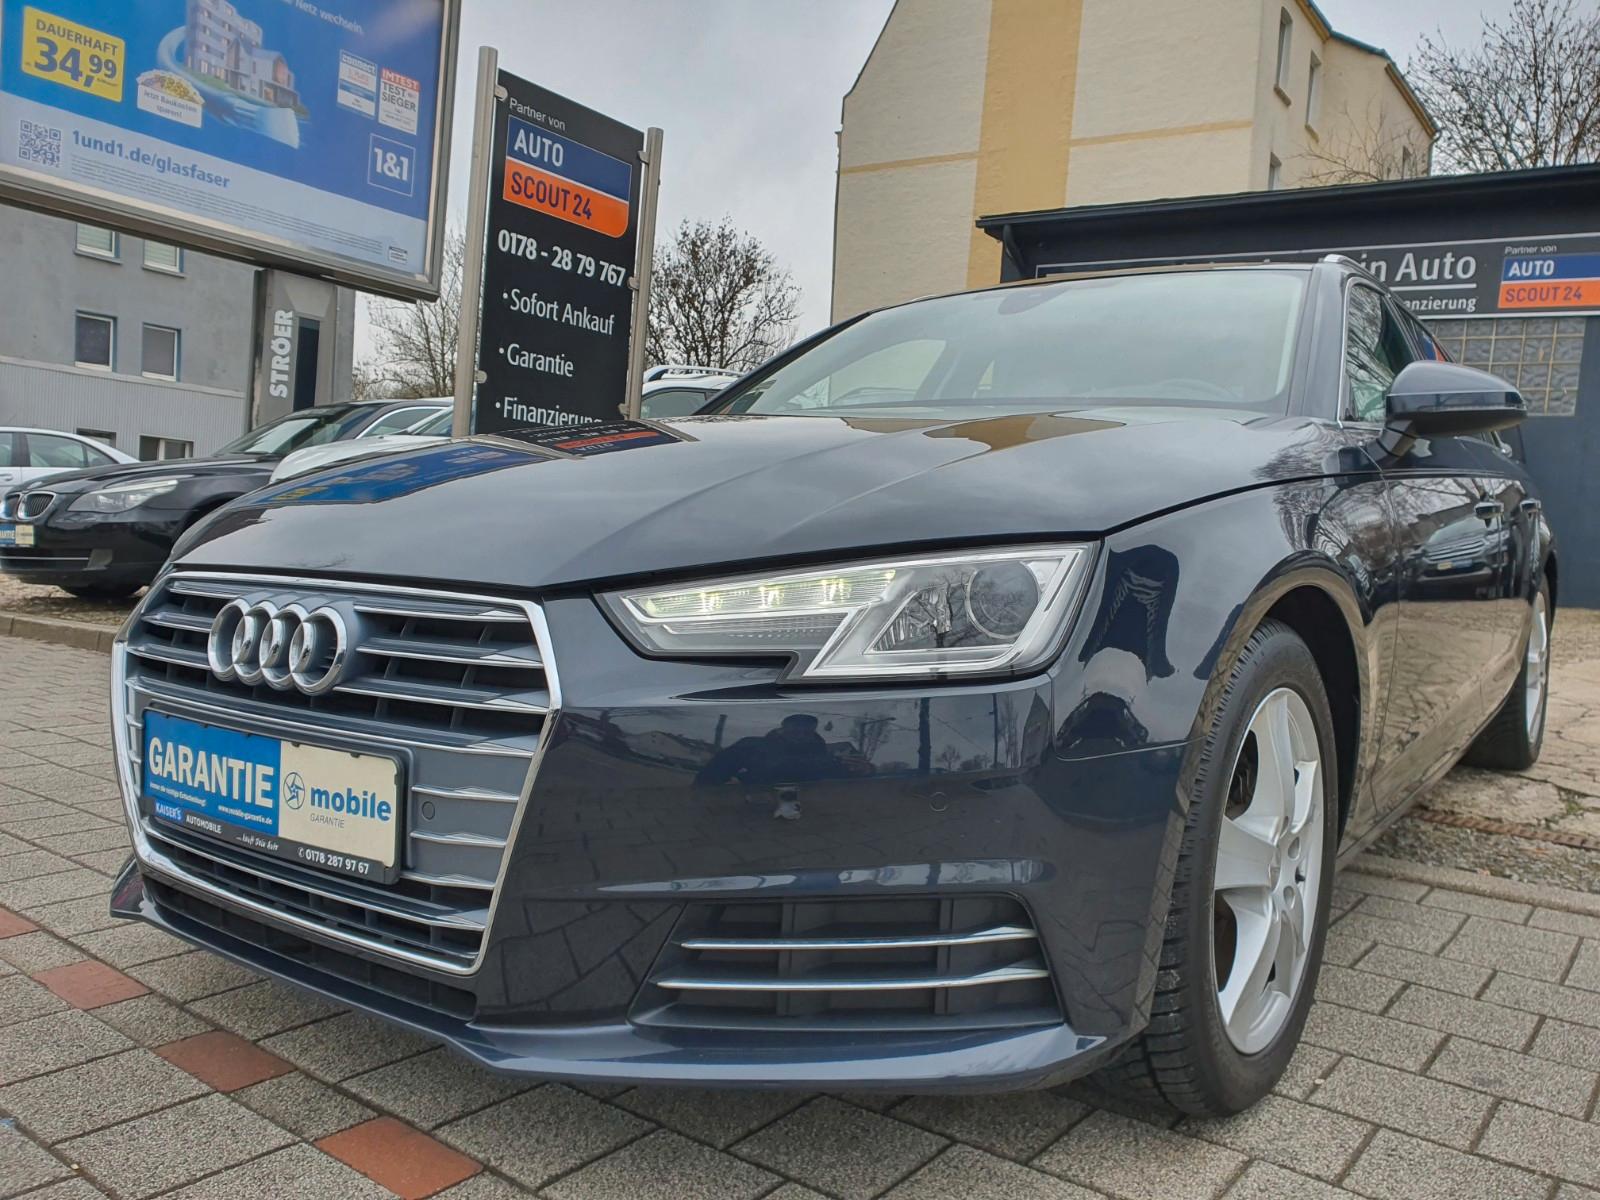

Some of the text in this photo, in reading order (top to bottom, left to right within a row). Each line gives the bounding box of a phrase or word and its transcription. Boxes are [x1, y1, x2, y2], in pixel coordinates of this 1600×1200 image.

[36, 19, 118, 56] DAUERHAFT
[382, 82, 406, 98] TEST
[382, 92, 417, 112] SIEGER
[509, 97, 566, 131] Partner von
[72, 130, 230, 187] 1und1.de/glasfaser
[374, 147, 408, 181] 1&1
[514, 128, 564, 167] AUTO
[498, 229, 537, 260] 0178
[551, 246, 572, 270] 28
[576, 253, 595, 278] 79
[600, 261, 626, 287] 767
[1395, 251, 1477, 282] Auto
[1504, 245, 1558, 255] Partner von
[1508, 260, 1556, 277] AUTO
[510, 288, 615, 335] Sofort Ankauf
[1404, 296, 1477, 313] anzierung
[269, 310, 293, 398] STRÖER
[507, 343, 574, 377] Garantie
[149, 737, 274, 808] GARANTIE
[310, 786, 392, 822] mobile
[310, 812, 345, 829] GARANTIE
[186, 814, 222, 834] AUTOMOBILE
[305, 849, 369, 875] 0178 287 97 67
